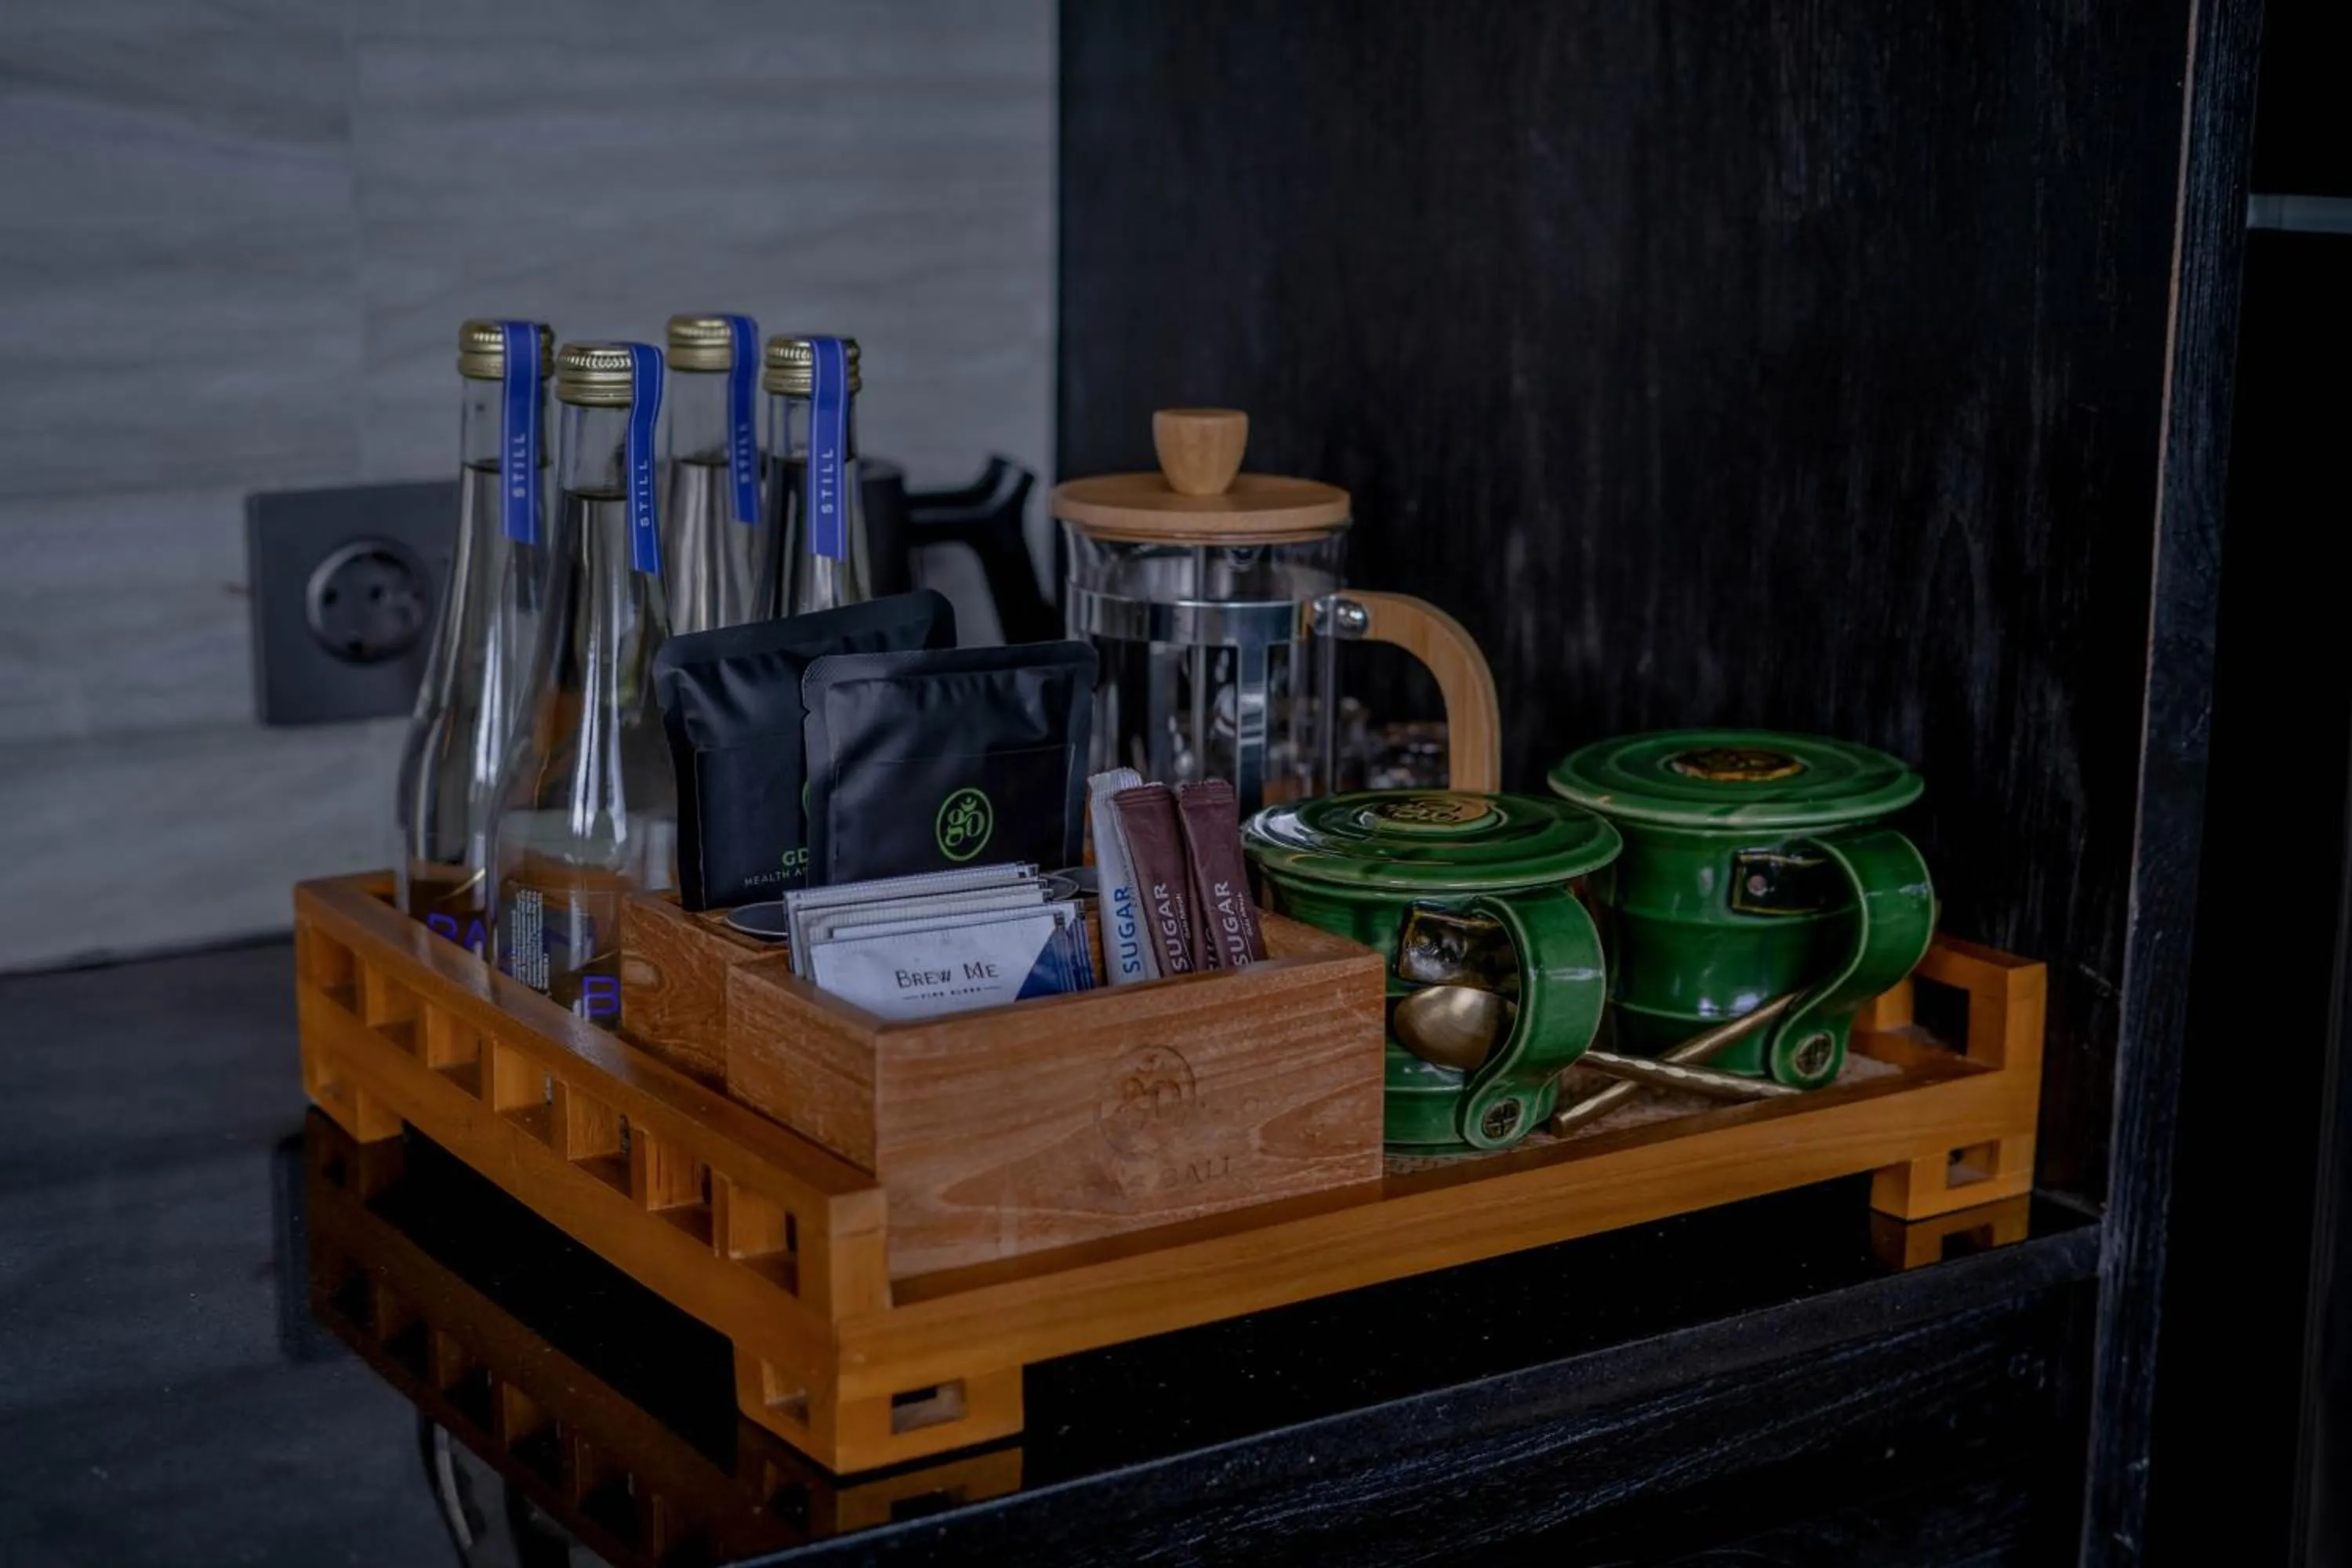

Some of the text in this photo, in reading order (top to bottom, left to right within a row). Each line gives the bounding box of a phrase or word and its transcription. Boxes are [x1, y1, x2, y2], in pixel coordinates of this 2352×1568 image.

[513, 433, 526, 499] STILL
[639, 460, 650, 528] STILL
[820, 448, 834, 514] STILL
[743, 869, 791, 887] HEALTH
[1114, 887, 1141, 974] SUGAR
[1153, 882, 1189, 971] SUGAR
[1215, 880, 1250, 966] SUGAR
